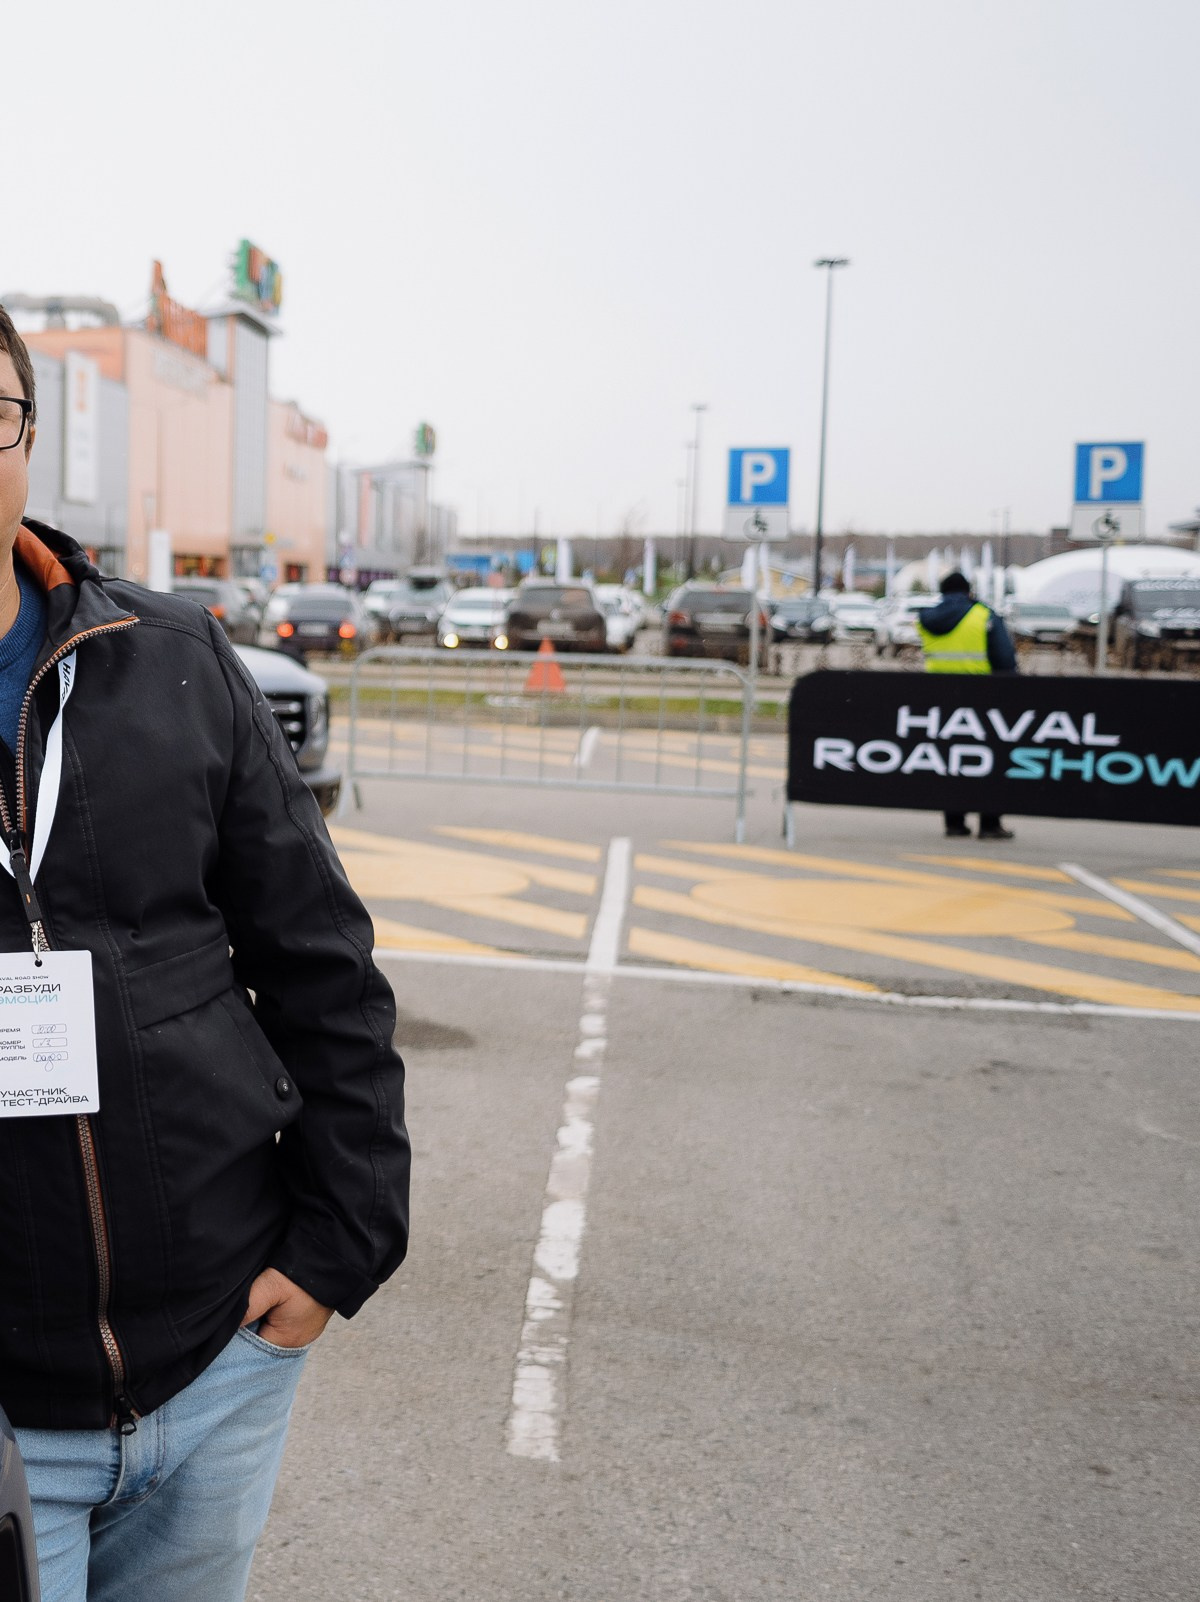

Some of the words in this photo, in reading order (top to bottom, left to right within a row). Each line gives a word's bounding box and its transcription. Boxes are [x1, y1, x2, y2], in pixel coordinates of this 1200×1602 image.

[740, 452, 776, 504] P
[1087, 445, 1128, 500] P
[896, 705, 1121, 747] HAVAL
[813, 737, 995, 777] ROAD
[1005, 747, 1200, 788] SHOW
[0, 1087, 67, 1098] УЧАСТНИК
[0, 1094, 89, 1107] ТЕСТ-ДРАЙВА
